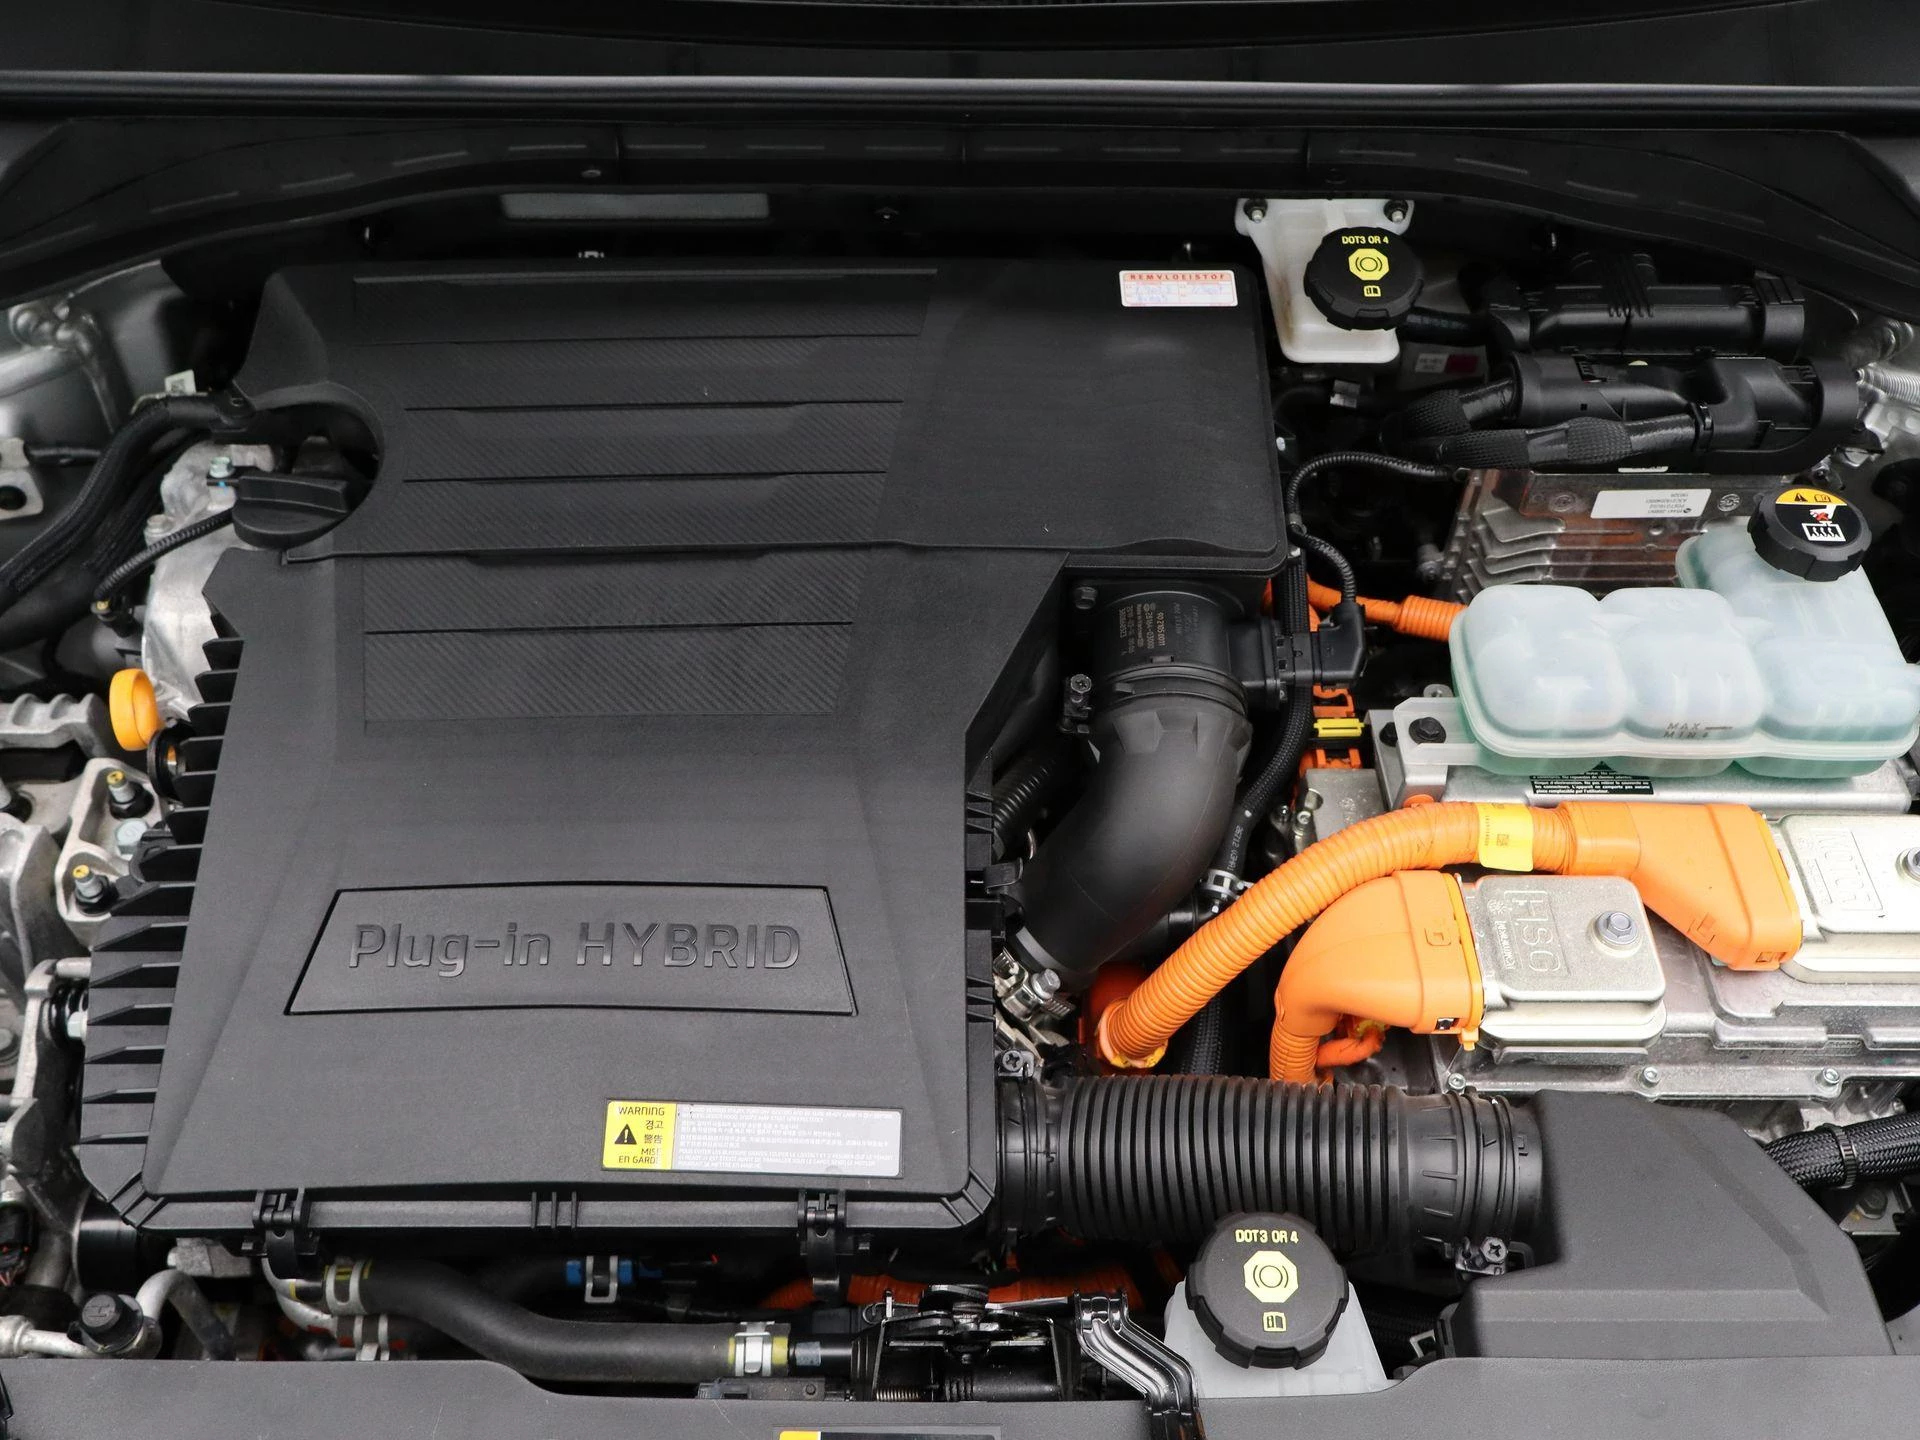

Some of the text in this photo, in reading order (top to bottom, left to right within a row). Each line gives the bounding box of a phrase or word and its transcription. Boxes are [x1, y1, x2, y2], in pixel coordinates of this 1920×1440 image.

[1341, 235, 1389, 244] DOT3 OR 4
[1666, 722, 1700, 730] MAX
[348, 921, 800, 978] Plug-in HYBRID
[618, 1106, 665, 1116] WARNING
[645, 1120, 664, 1130] 경고
[618, 1155, 659, 1164] EN GARD
[1235, 1229, 1299, 1244] DOT3 OR 4
